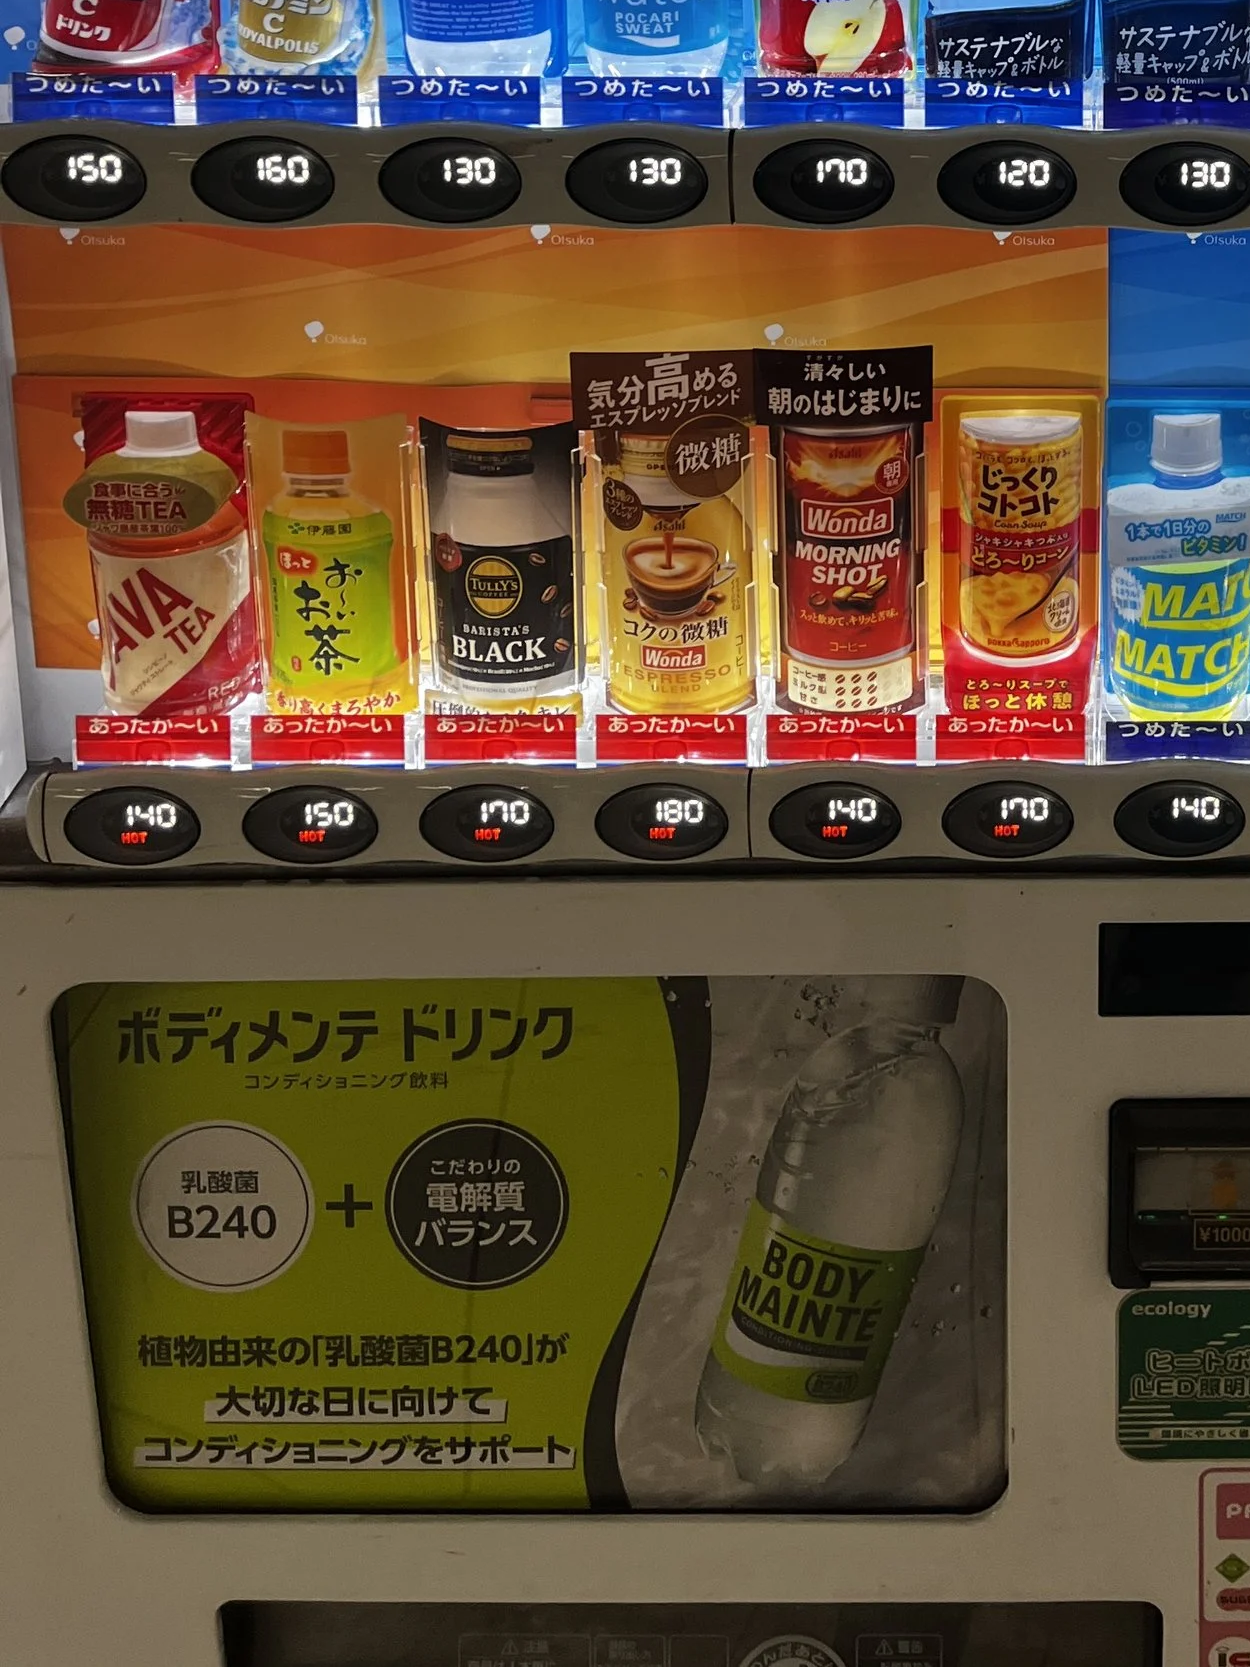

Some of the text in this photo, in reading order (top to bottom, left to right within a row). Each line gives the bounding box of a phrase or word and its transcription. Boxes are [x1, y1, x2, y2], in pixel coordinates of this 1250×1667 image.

[56, 14, 112, 42] ドリンク
[938, 32, 1065, 58] サステナブルな
[67, 153, 123, 184] 150
[256, 154, 311, 186] 160
[628, 156, 682, 186] 130
[815, 157, 868, 186] 170
[998, 159, 1051, 188] 120
[1180, 160, 1232, 189] 130
[804, 361, 886, 382] 清々しい
[767, 385, 922, 415] 朝のはじまりに
[675, 433, 743, 476] 微糖
[93, 482, 173, 499] 食事に合う
[981, 464, 1058, 491] じっくり
[87, 498, 188, 521] 無糖TEA
[977, 490, 1060, 518] コトコト
[807, 508, 888, 534] Wonda
[794, 538, 902, 565] MORNING
[623, 616, 729, 644] コクの微糖
[451, 635, 547, 664] BLACK
[643, 648, 704, 668] Wonda
[962, 693, 1074, 711] ほっと休憩
[125, 804, 177, 827] 140
[304, 803, 355, 827] 150
[480, 800, 531, 825] 170
[656, 798, 705, 823] 180
[827, 797, 878, 822] 140
[1171, 796, 1220, 820] 140
[121, 831, 148, 845] HOT
[649, 826, 677, 841] HOT
[117, 1003, 574, 1064] ボディメンテ ドリンク
[243, 1070, 450, 1091] コンディショニング飲料
[429, 1158, 522, 1176] こだわりの
[180, 1170, 260, 1195] 乳酸菌
[425, 1181, 526, 1214] 電解質
[167, 1204, 277, 1240] B240
[413, 1218, 538, 1248] バランス
[762, 1239, 876, 1303] BODY
[1131, 1300, 1212, 1319] ecology
[215, 1385, 494, 1418] 大切な日に向けて
[143, 1435, 572, 1466] コンディショニングをサポート
